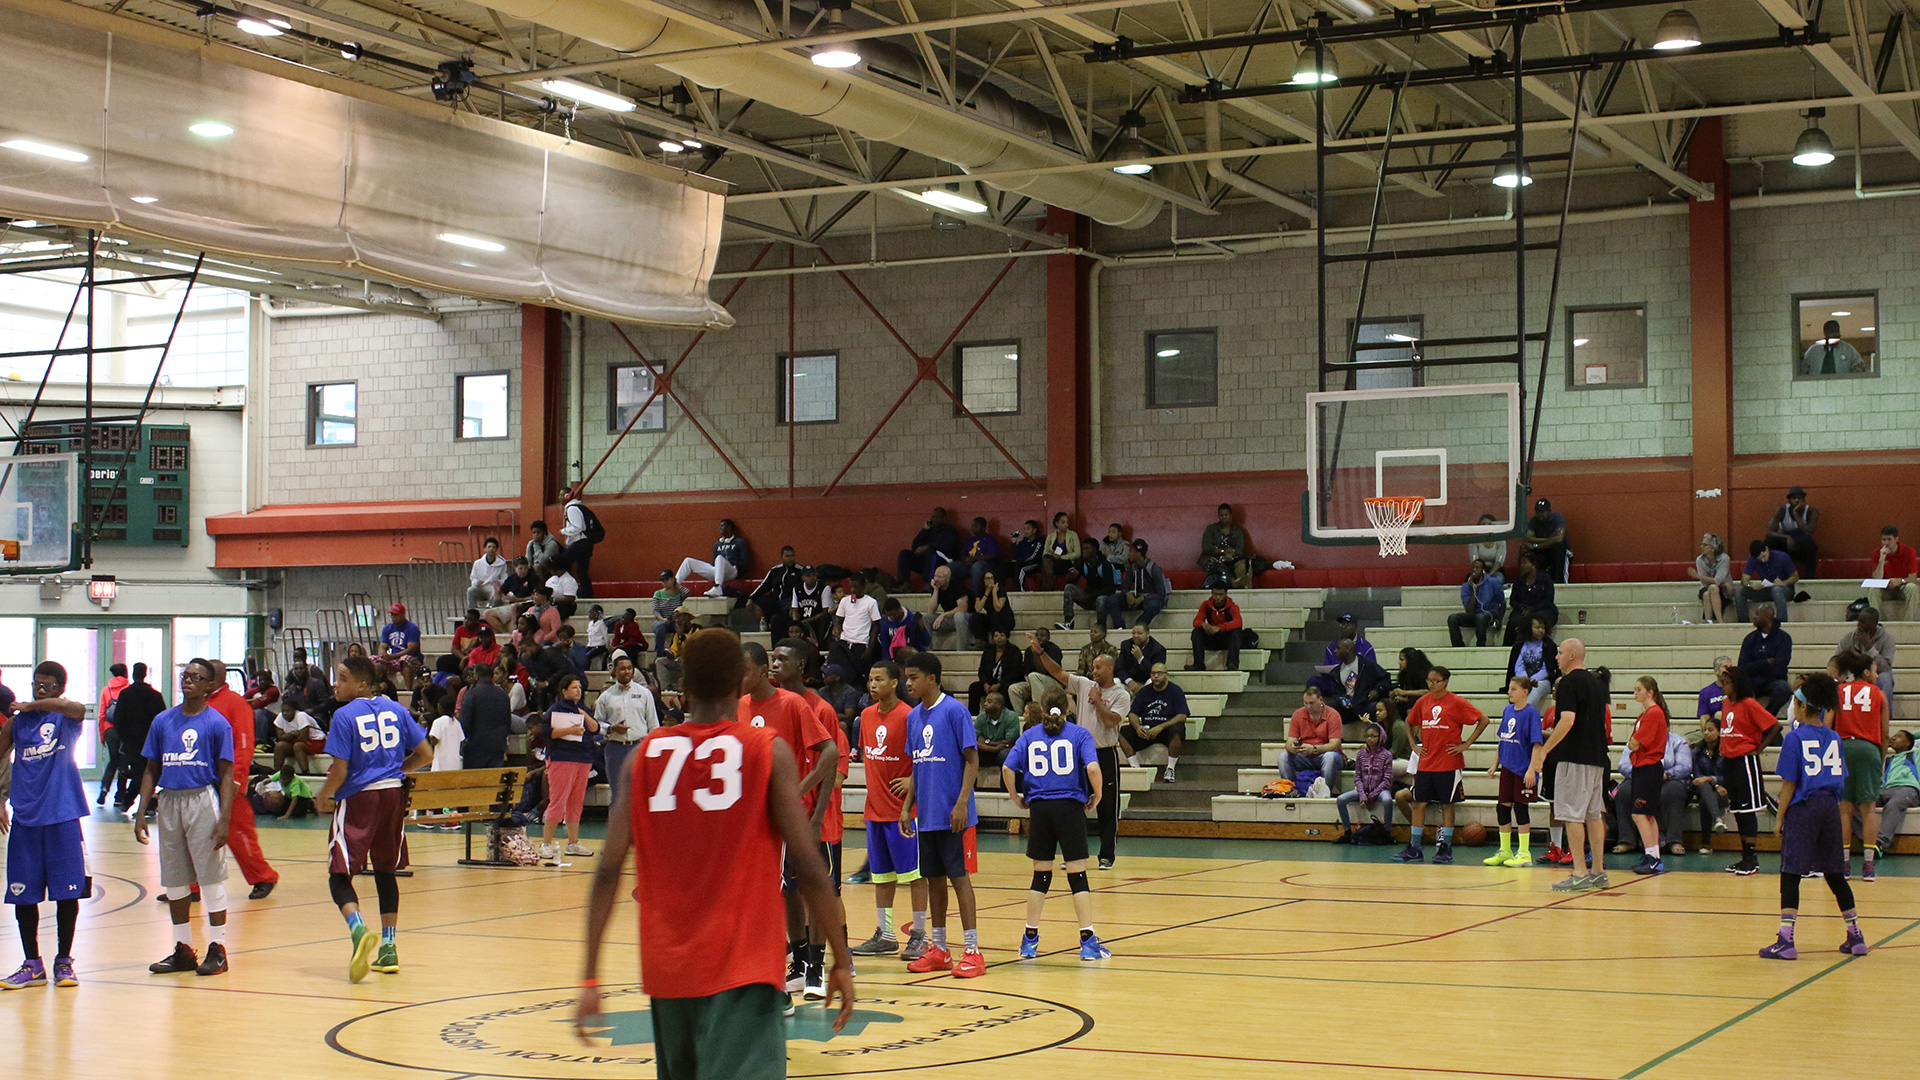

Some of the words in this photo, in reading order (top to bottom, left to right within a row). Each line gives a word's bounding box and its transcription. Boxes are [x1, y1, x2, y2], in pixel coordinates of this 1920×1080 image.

[93, 582, 115, 597] EXIT
[803, 607, 812, 617] 34
[1842, 684, 1872, 712] 14
[355, 711, 400, 753] 56
[1028, 739, 1074, 777] 60
[1802, 740, 1843, 776] 54
[645, 735, 743, 812] 73
[907, 1002, 1003, 1010] NEW
[961, 1008, 1056, 1028] OFFICE
[931, 1028, 976, 1037] OF
[493, 1050, 659, 1064] EATION
